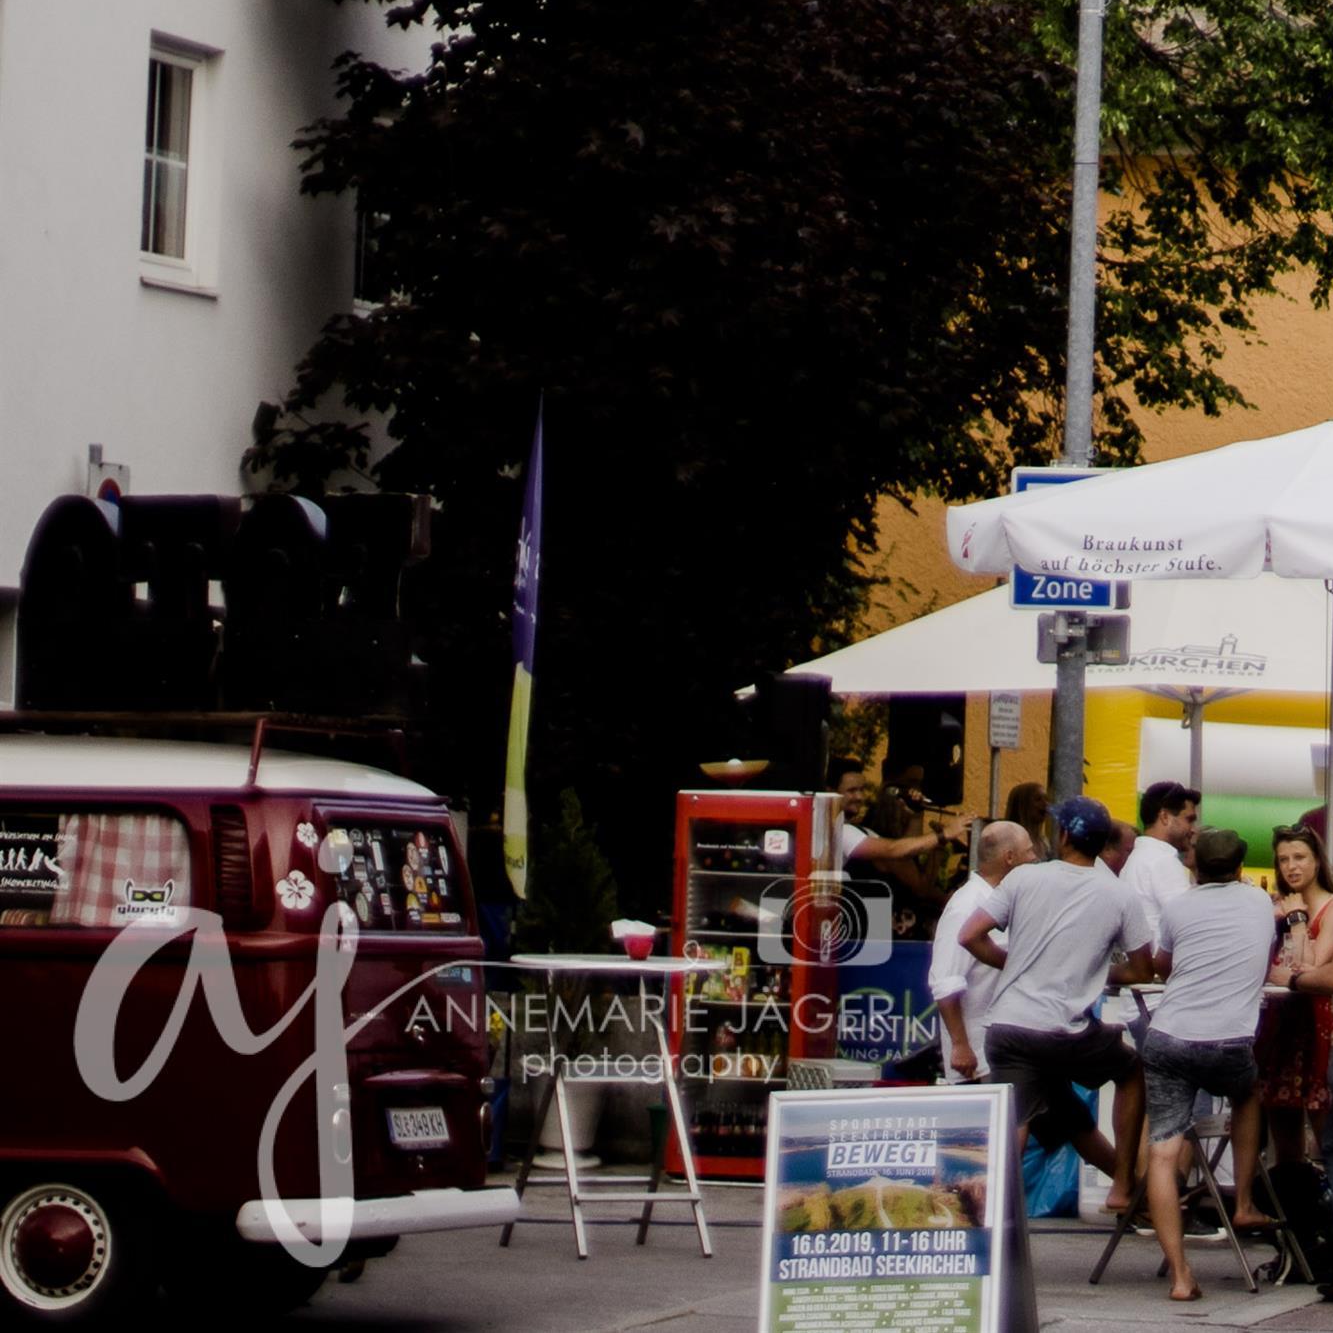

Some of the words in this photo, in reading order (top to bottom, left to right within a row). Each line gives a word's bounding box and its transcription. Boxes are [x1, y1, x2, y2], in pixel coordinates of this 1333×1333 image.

[1083, 534, 1184, 552] Braukunst
[1040, 554, 1070, 571] auf
[1078, 555, 1160, 574] höchster
[1165, 555, 1223, 572] Stufe.
[1031, 575, 1093, 600] Zone
[1128, 655, 1266, 672] KIRCHEN
[829, 1116, 939, 1131] SPORTSTADT
[829, 1129, 938, 1143] SEEKIRCHEN
[831, 1142, 934, 1166] BEWEGT
[792, 1232, 876, 1255] 16.6.2019,
[882, 1231, 929, 1252] 11-16
[933, 1230, 967, 1252] UHR
[779, 1256, 873, 1280] STRANDBAD
[875, 1254, 976, 1276] SEEKIRCHEN
